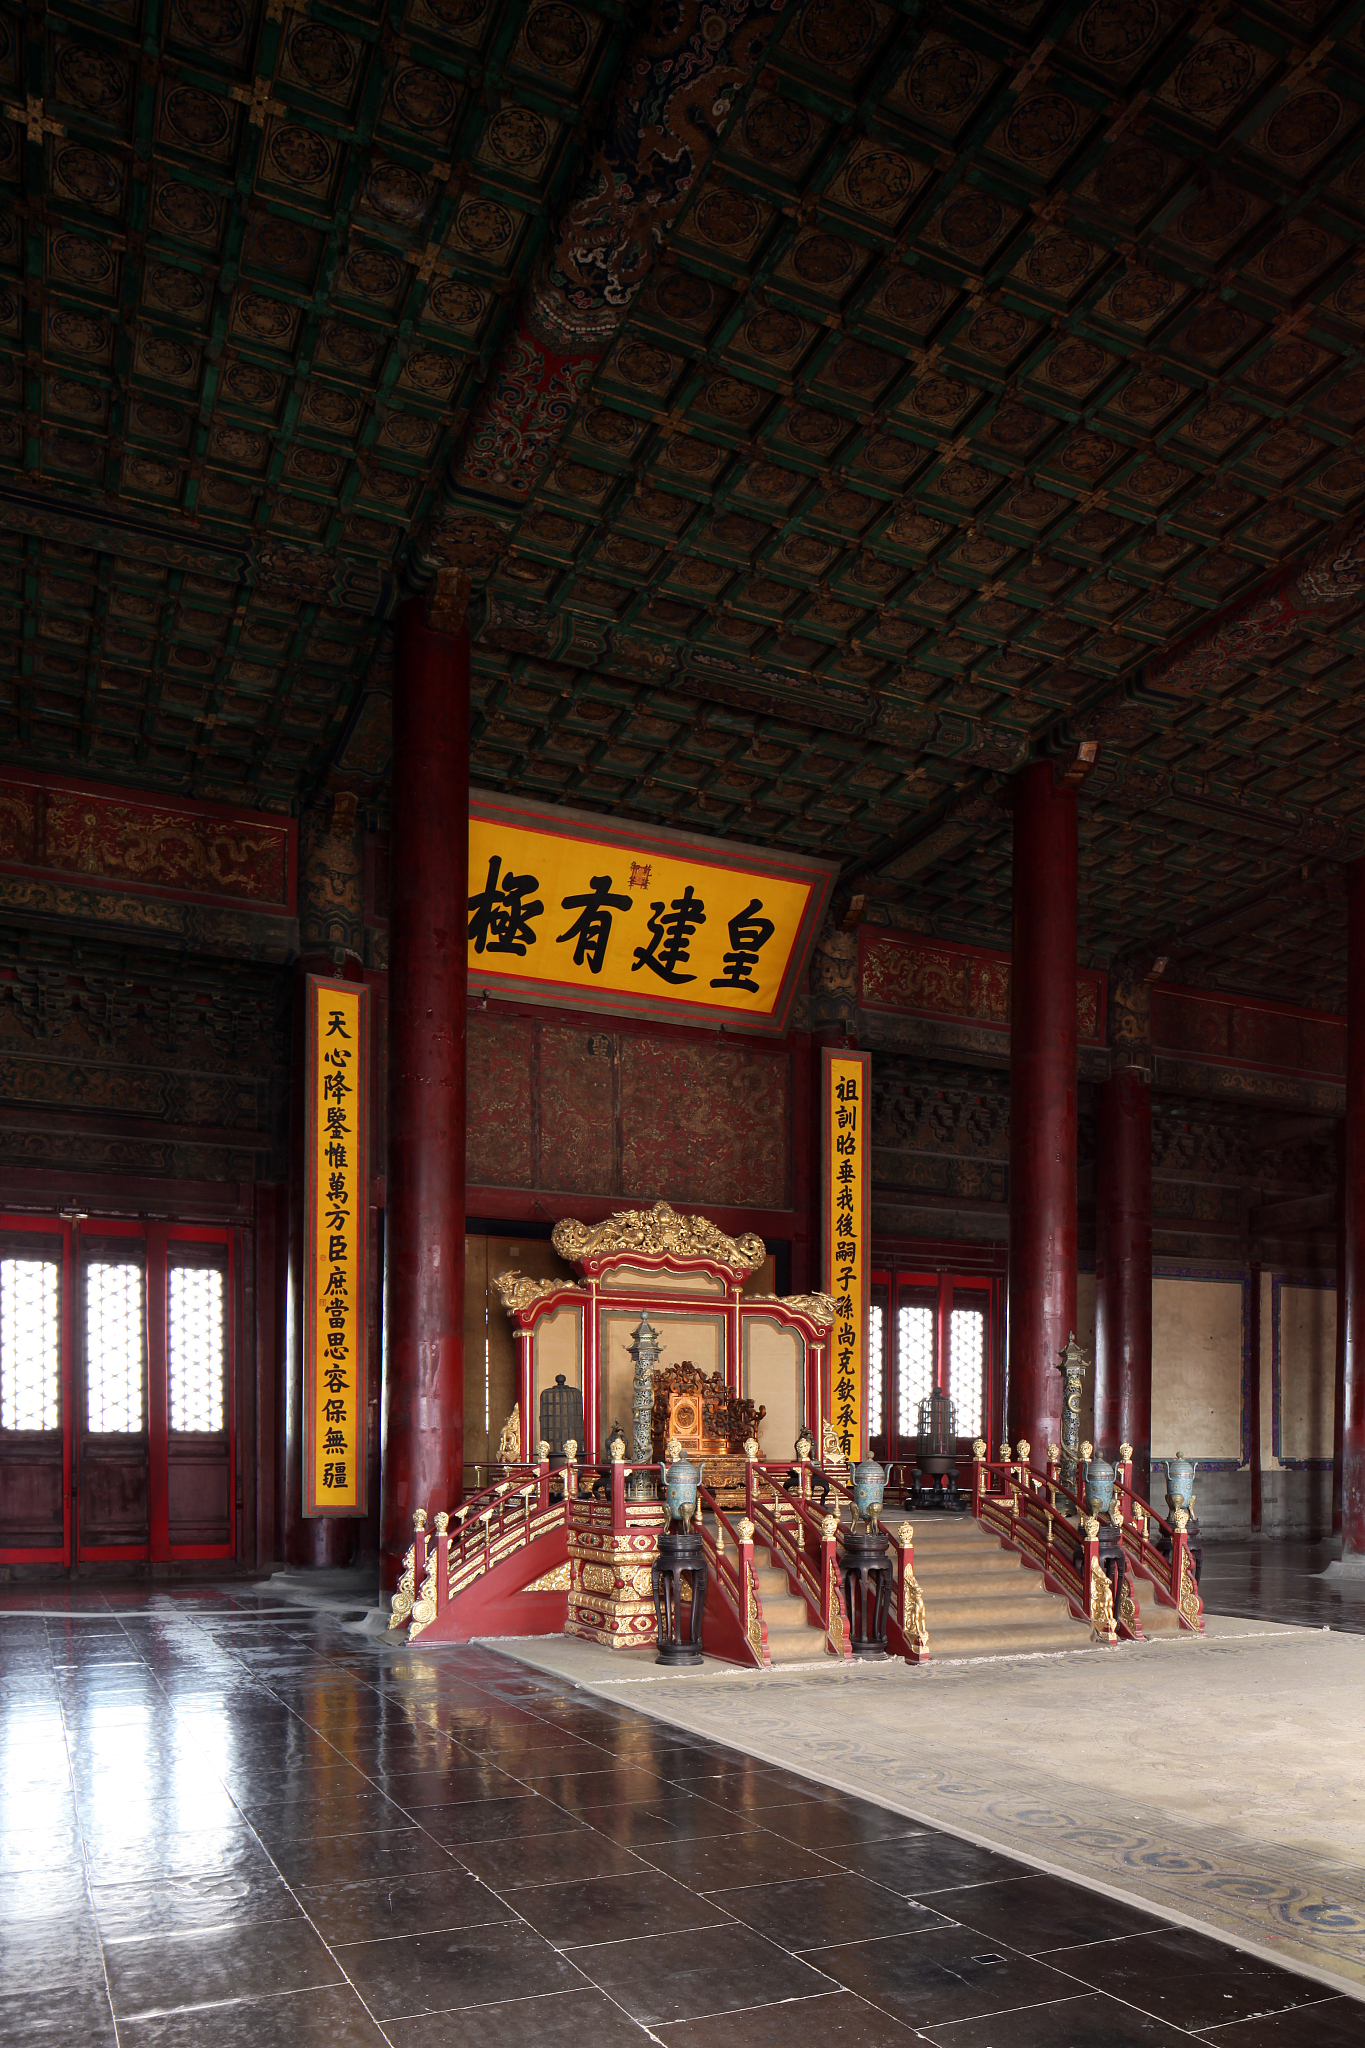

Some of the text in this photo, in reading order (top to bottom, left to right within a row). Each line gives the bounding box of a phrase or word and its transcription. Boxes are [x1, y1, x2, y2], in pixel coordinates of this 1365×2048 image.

[833, 1075, 859, 1480] 祖訓昭垂我後嗣子孫尚克欽承有
